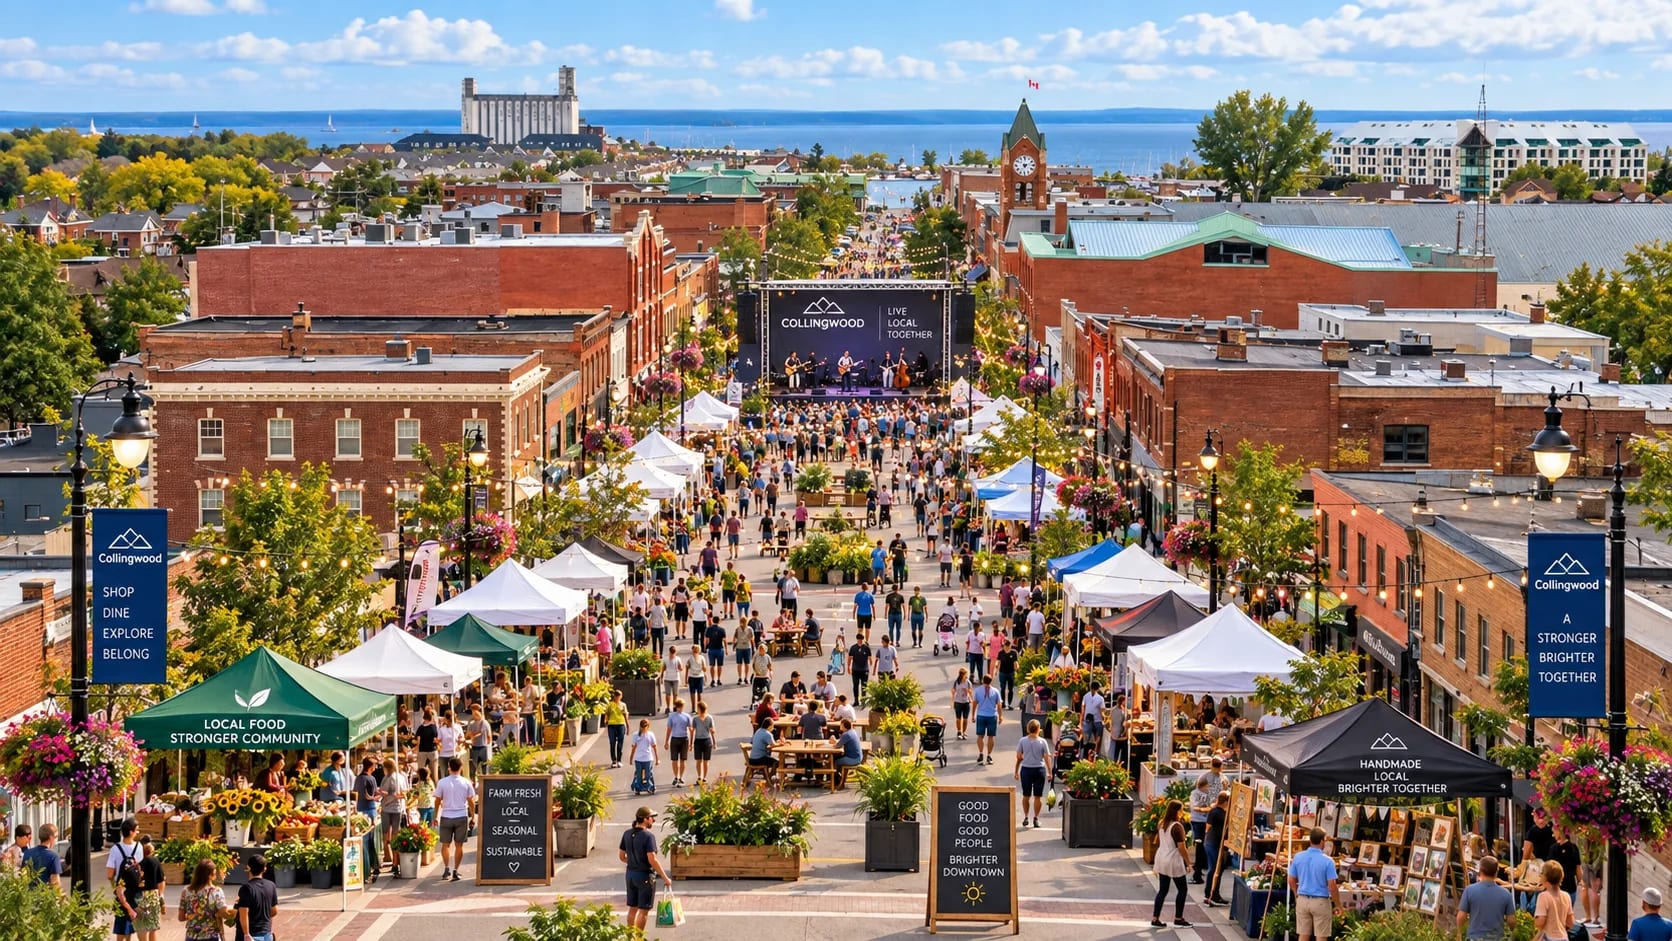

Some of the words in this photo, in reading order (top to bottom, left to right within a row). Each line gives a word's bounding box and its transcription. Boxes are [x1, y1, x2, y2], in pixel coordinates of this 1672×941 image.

[887, 306, 908, 316] LIVE
[887, 318, 918, 328] LOCAL
[887, 330, 933, 339] TOGETHER
[98, 552, 162, 565] Collingwood
[1534, 579, 1600, 592] Collingwood
[102, 586, 135, 597] SHOP
[103, 607, 130, 618] DINE
[1562, 613, 1572, 624] A
[103, 627, 154, 638] EXPLORE
[1537, 632, 1597, 643] STRONGER
[103, 648, 150, 659] BELONG
[1539, 651, 1595, 662] BRIGHTER
[1538, 671, 1597, 682] TOGETHER
[204, 718, 246, 729] LOCAL
[249, 718, 286, 729] FOOD
[170, 732, 239, 743] STRONGER
[242, 733, 321, 743] COMMUNITY
[1359, 759, 1422, 769] HANDMADE
[1374, 771, 1410, 781] LOCAL
[488, 788, 513, 798] FARM
[514, 788, 542, 798] FRESH
[1337, 783, 1390, 793] BRIGHTER
[1392, 783, 1448, 793] TOGETHER
[958, 800, 990, 810] GOOD
[501, 806, 529, 816] LOCAL
[959, 813, 989, 823] FOOD
[492, 825, 538, 835] SEASONAL
[958, 826, 989, 836] GOOD
[954, 838, 993, 848] PEOPLE
[486, 846, 543, 856] SUSTAINABLE
[949, 854, 998, 864] BRIGHTER
[943, 867, 1005, 877] DOWNTOWN
